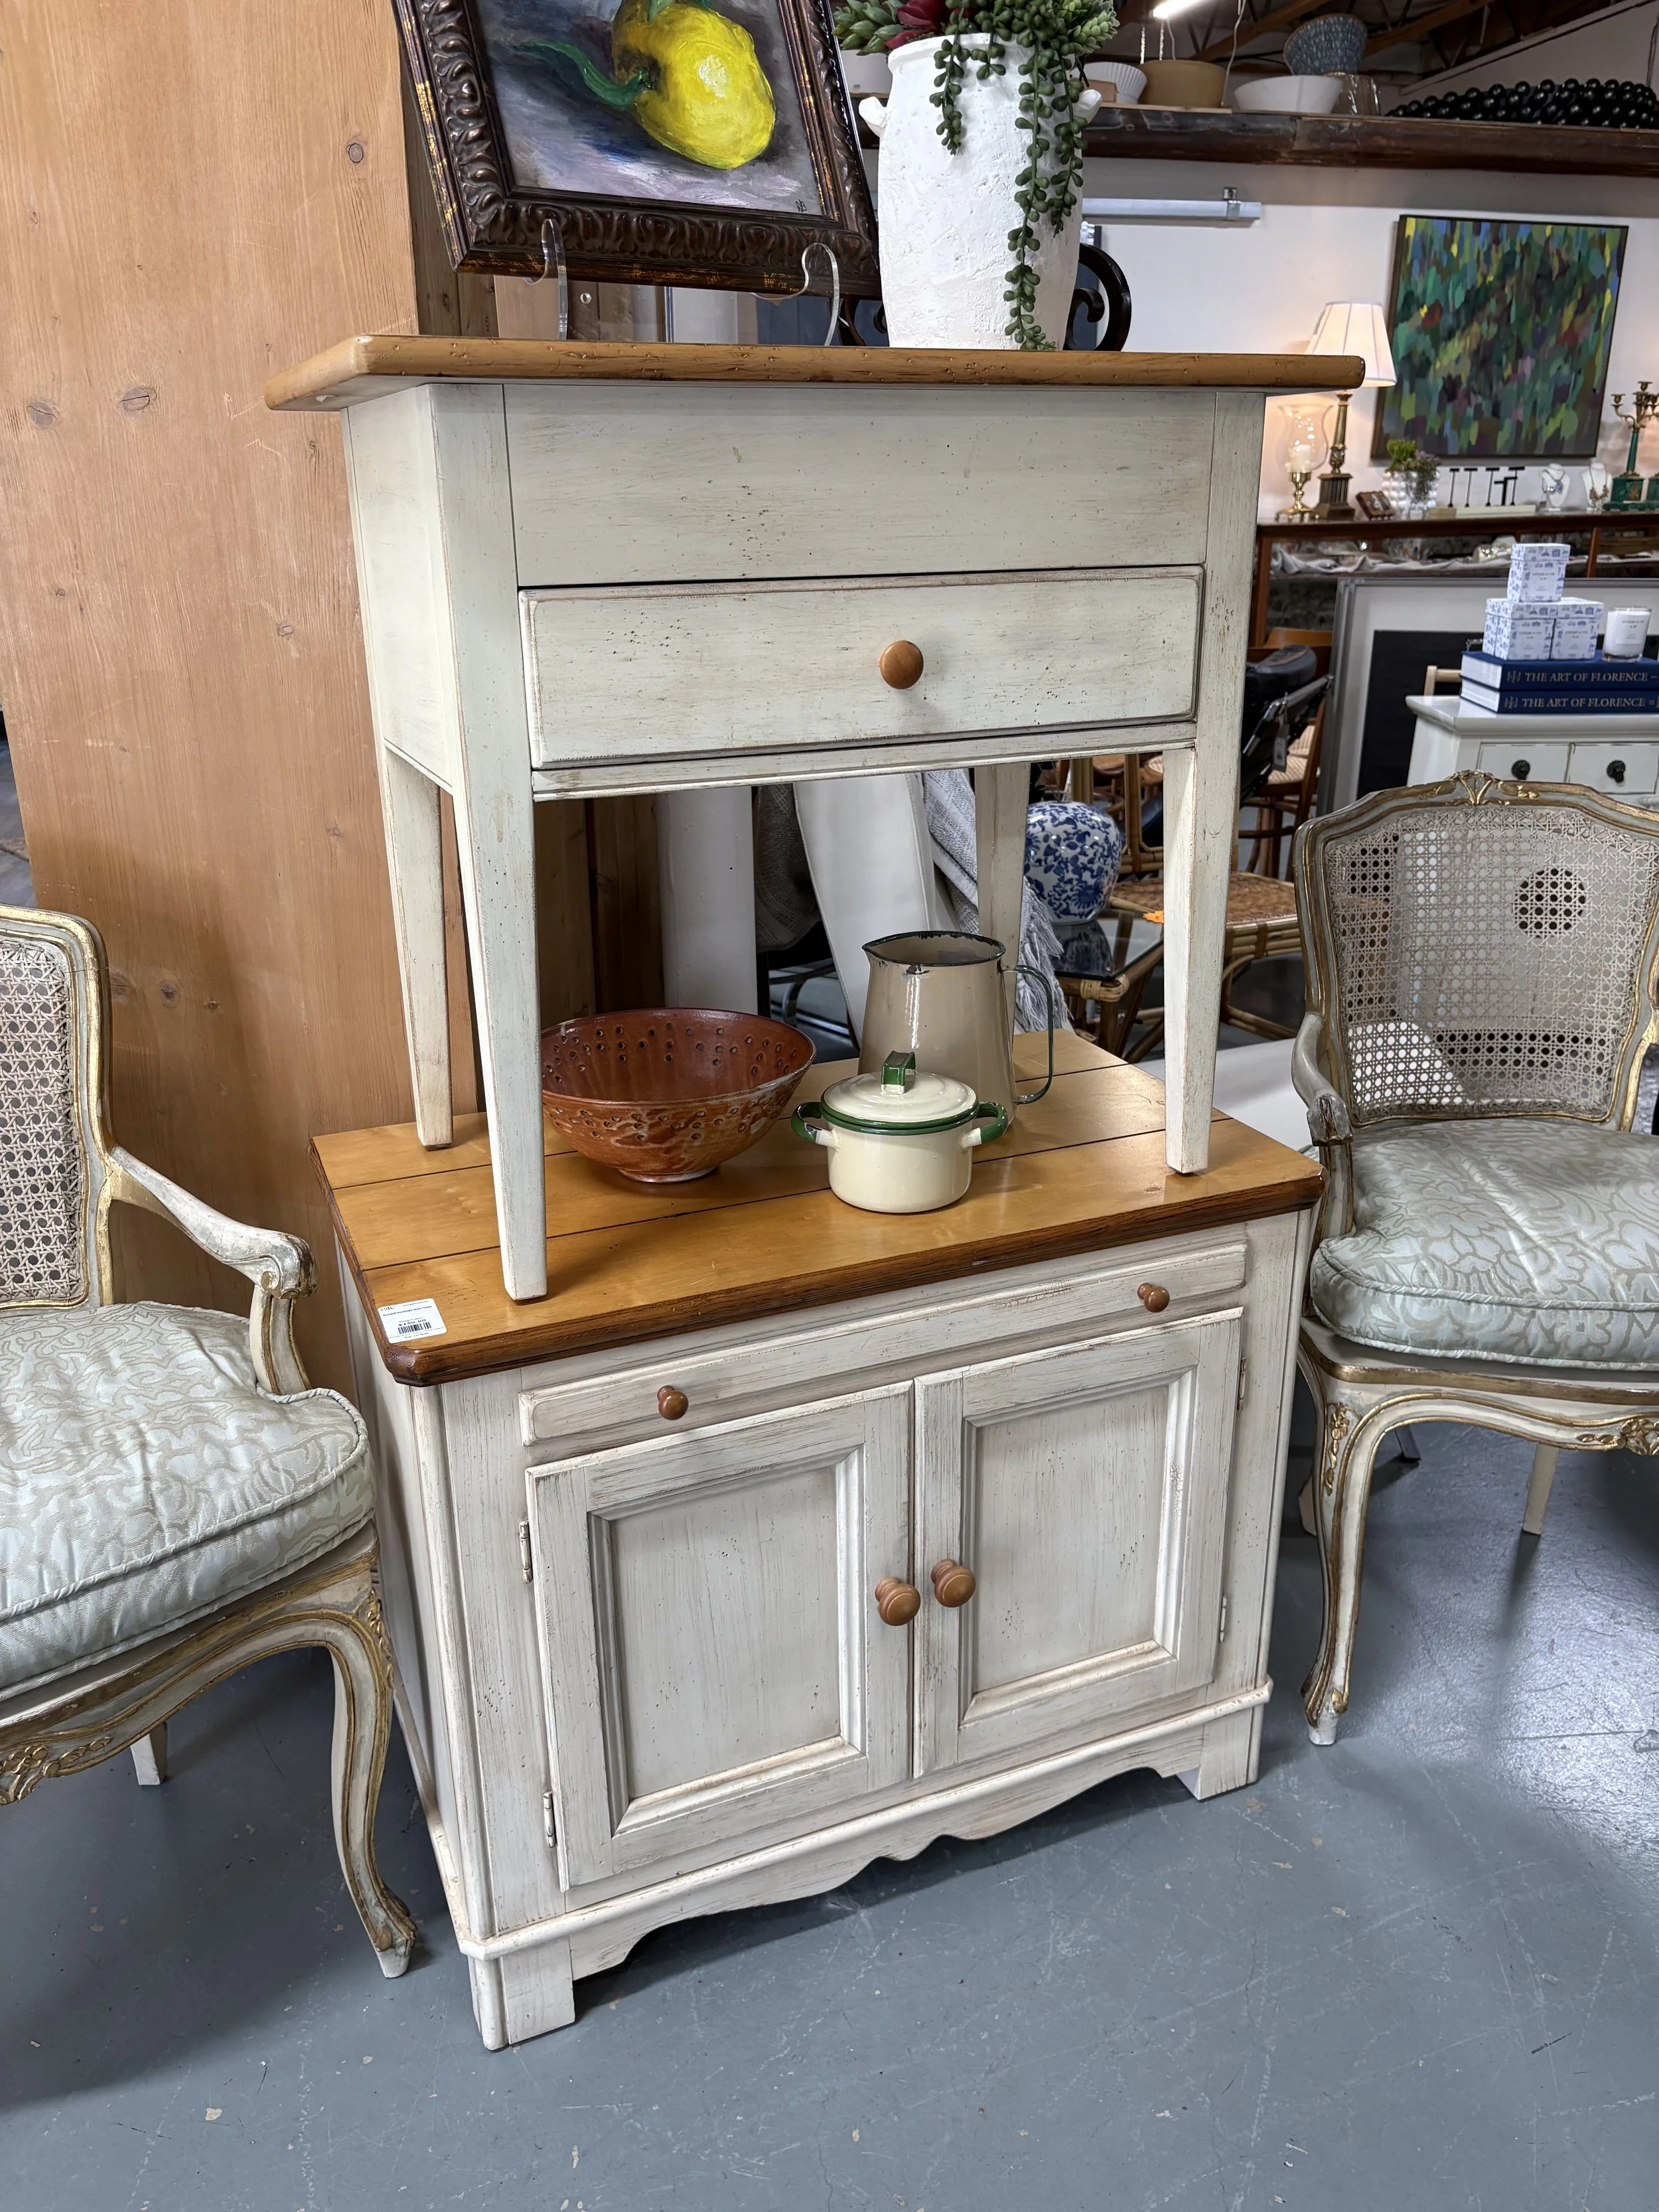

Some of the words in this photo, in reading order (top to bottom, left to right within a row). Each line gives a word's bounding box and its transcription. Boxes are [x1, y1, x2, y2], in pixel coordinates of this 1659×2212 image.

[1524, 672, 1548, 682] THE
[1550, 672, 1572, 682] ART
[1573, 672, 1589, 682] OF
[1591, 671, 1649, 682] FLORENCE
[1522, 698, 1545, 707] THE
[1546, 698, 1569, 707] ART
[1570, 698, 1586, 707] OF
[1587, 698, 1646, 707] FLORENCE
